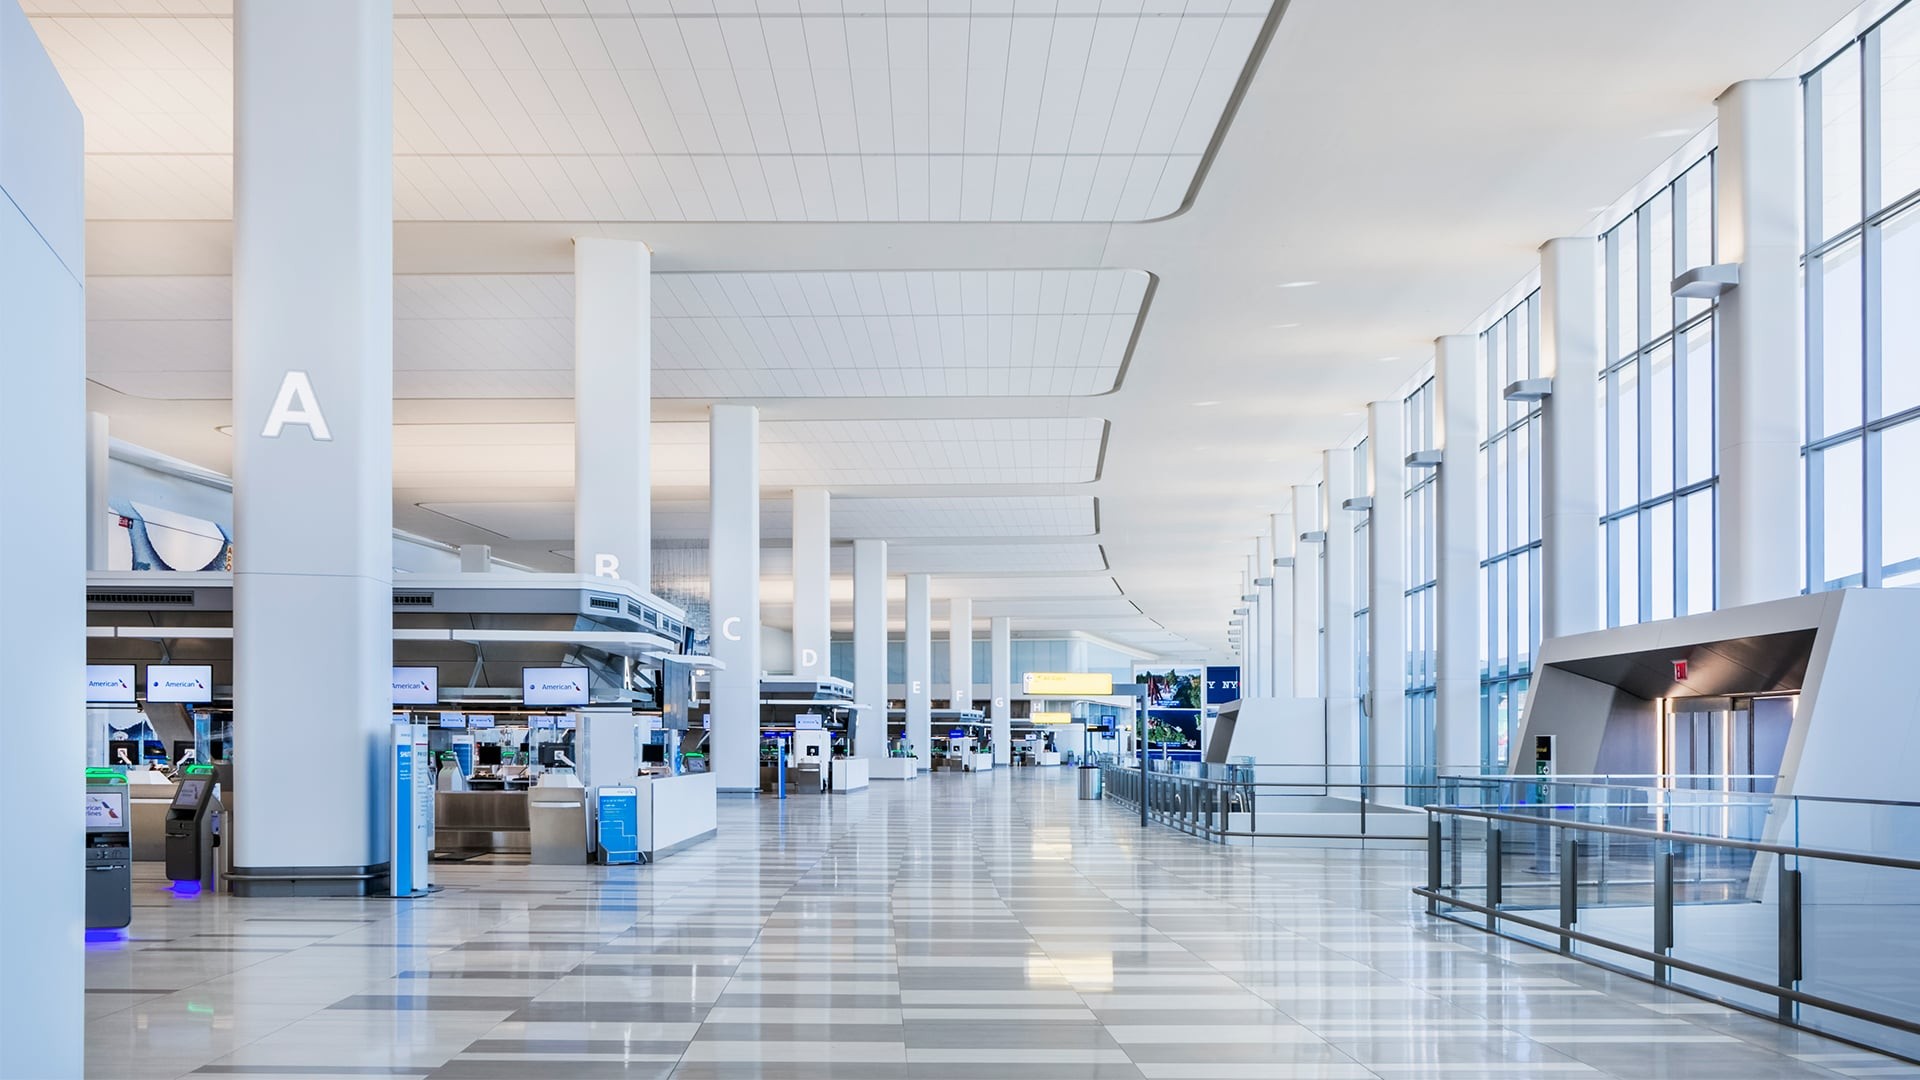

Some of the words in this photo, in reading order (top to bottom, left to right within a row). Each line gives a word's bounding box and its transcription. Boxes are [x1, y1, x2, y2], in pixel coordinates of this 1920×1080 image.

[260, 370, 333, 441] A
[722, 616, 741, 641] C
[802, 648, 818, 667] D
[912, 681, 921, 694] E
[1222, 681, 1238, 689] NY
[956, 690, 964, 702] F
[995, 697, 1004, 708] G
